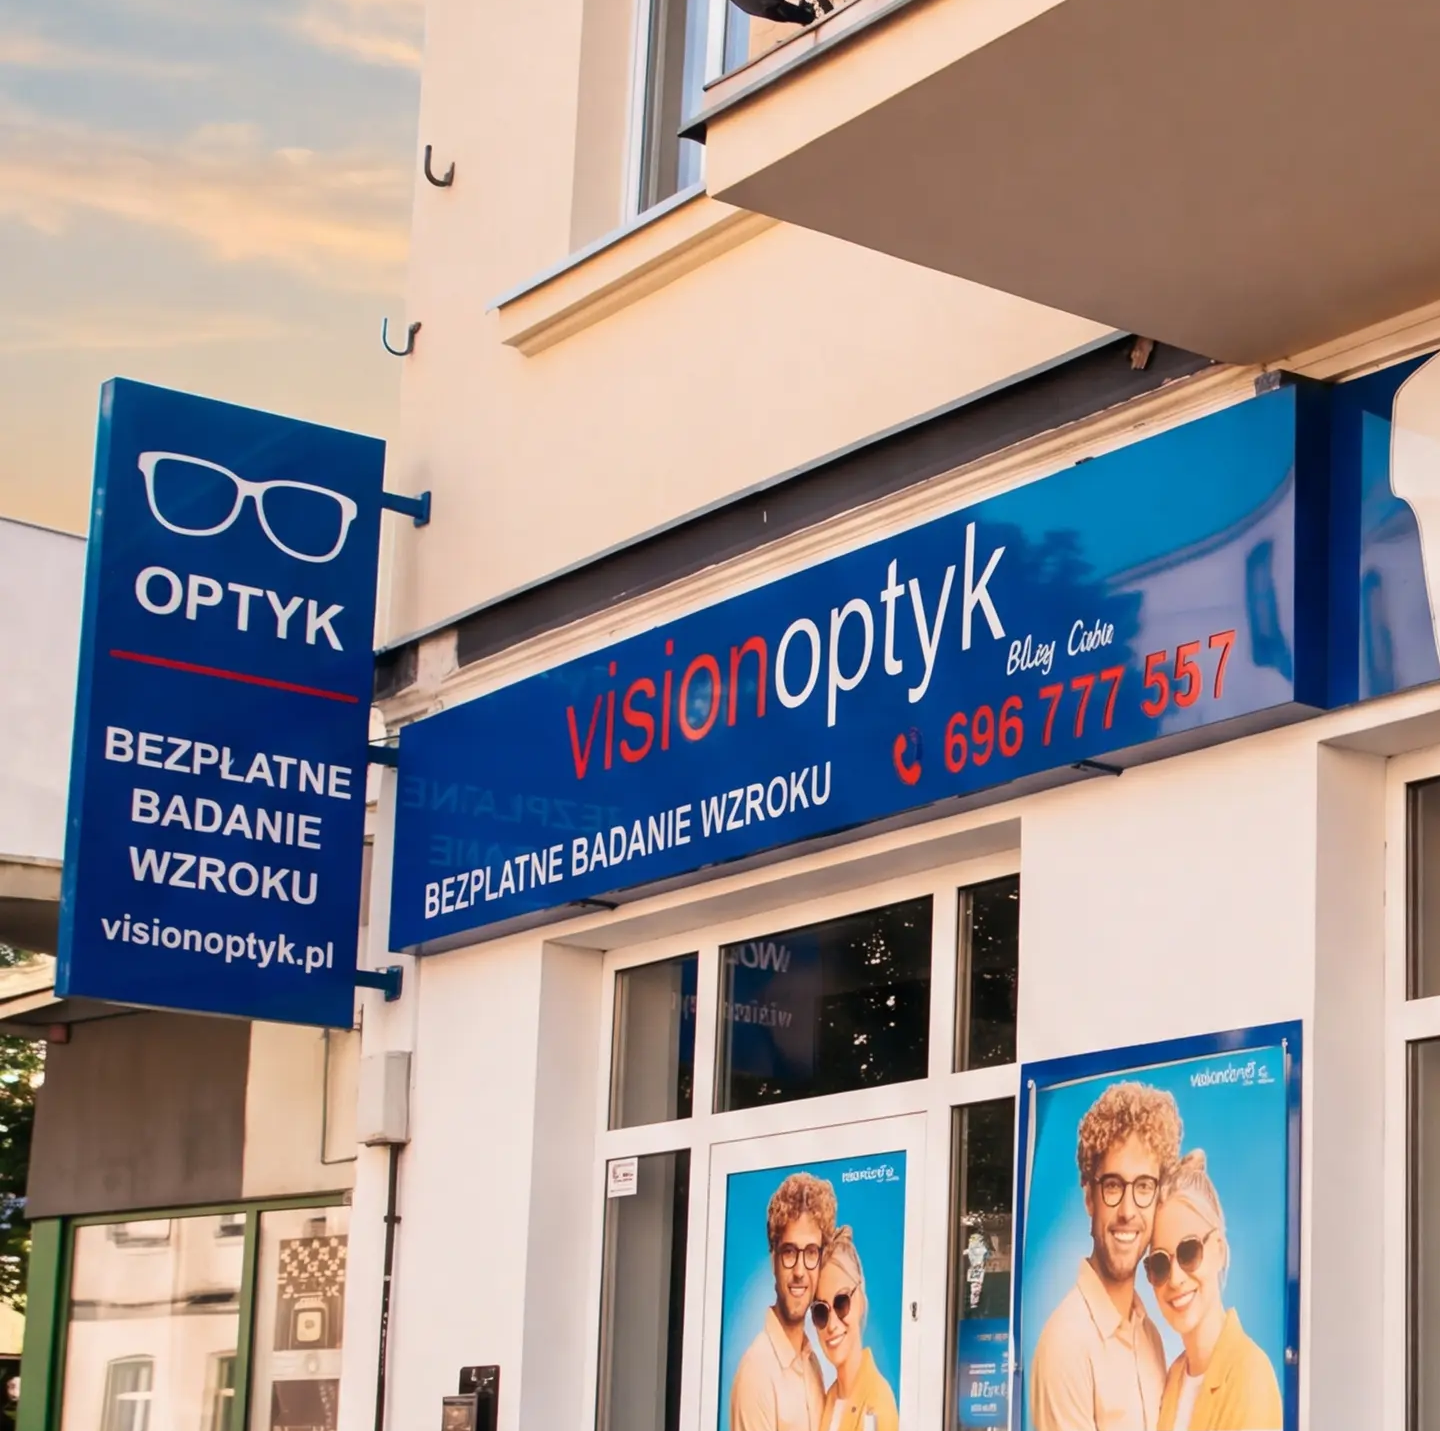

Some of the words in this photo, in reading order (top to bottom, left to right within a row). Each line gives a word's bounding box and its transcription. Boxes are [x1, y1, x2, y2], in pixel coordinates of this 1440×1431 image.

[135, 566, 345, 651] OPTYK
[566, 521, 1006, 780] visionoptyk
[944, 695, 1024, 773] 696
[1039, 665, 1126, 746] 777
[1141, 629, 1236, 718] 557
[104, 726, 353, 800] BEZPŁATNE
[131, 787, 322, 850] BADANIE
[571, 804, 692, 876] BADANIE
[700, 761, 832, 838] WZROKU
[129, 845, 319, 906] WZROKU
[101, 916, 335, 974] visionoptyk.pl
